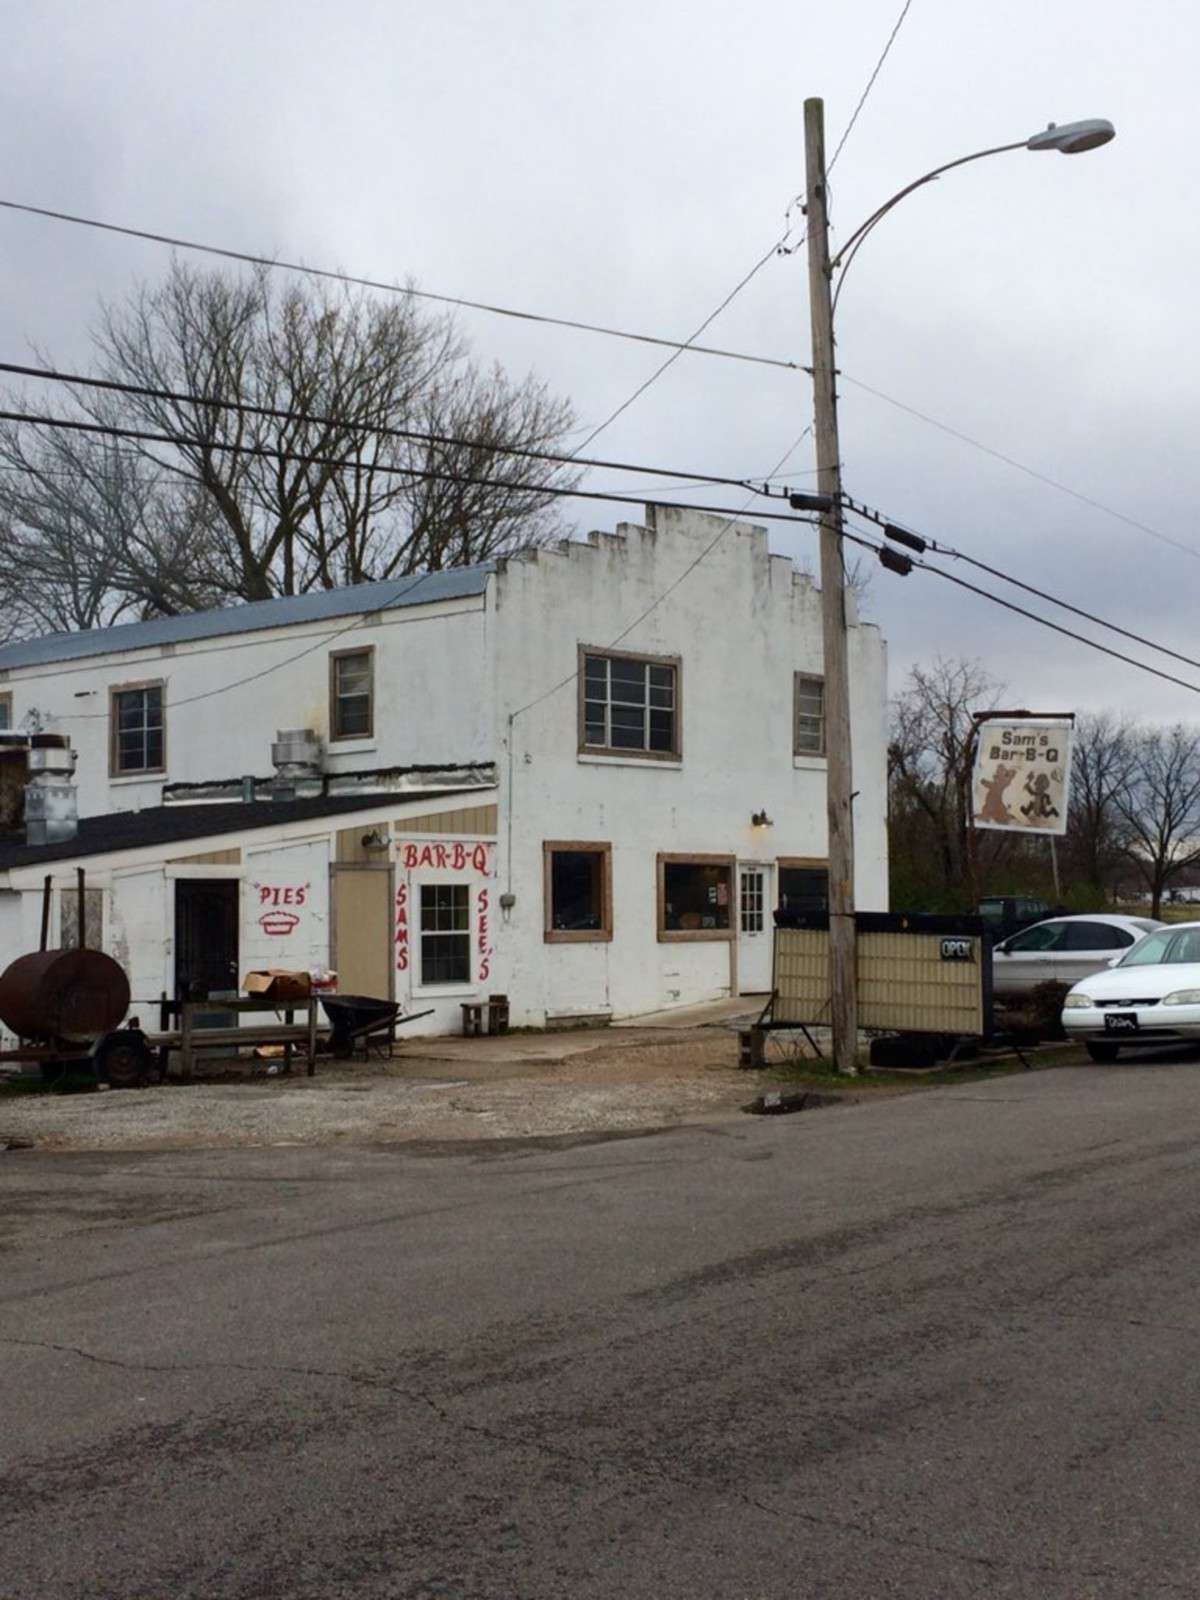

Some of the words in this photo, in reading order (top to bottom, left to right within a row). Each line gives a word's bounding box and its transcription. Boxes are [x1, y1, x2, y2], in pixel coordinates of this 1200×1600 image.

[1001, 730, 1049, 746] Sam's
[989, 746, 1058, 762] Bar-B-Q
[395, 883, 408, 971] SAMS
